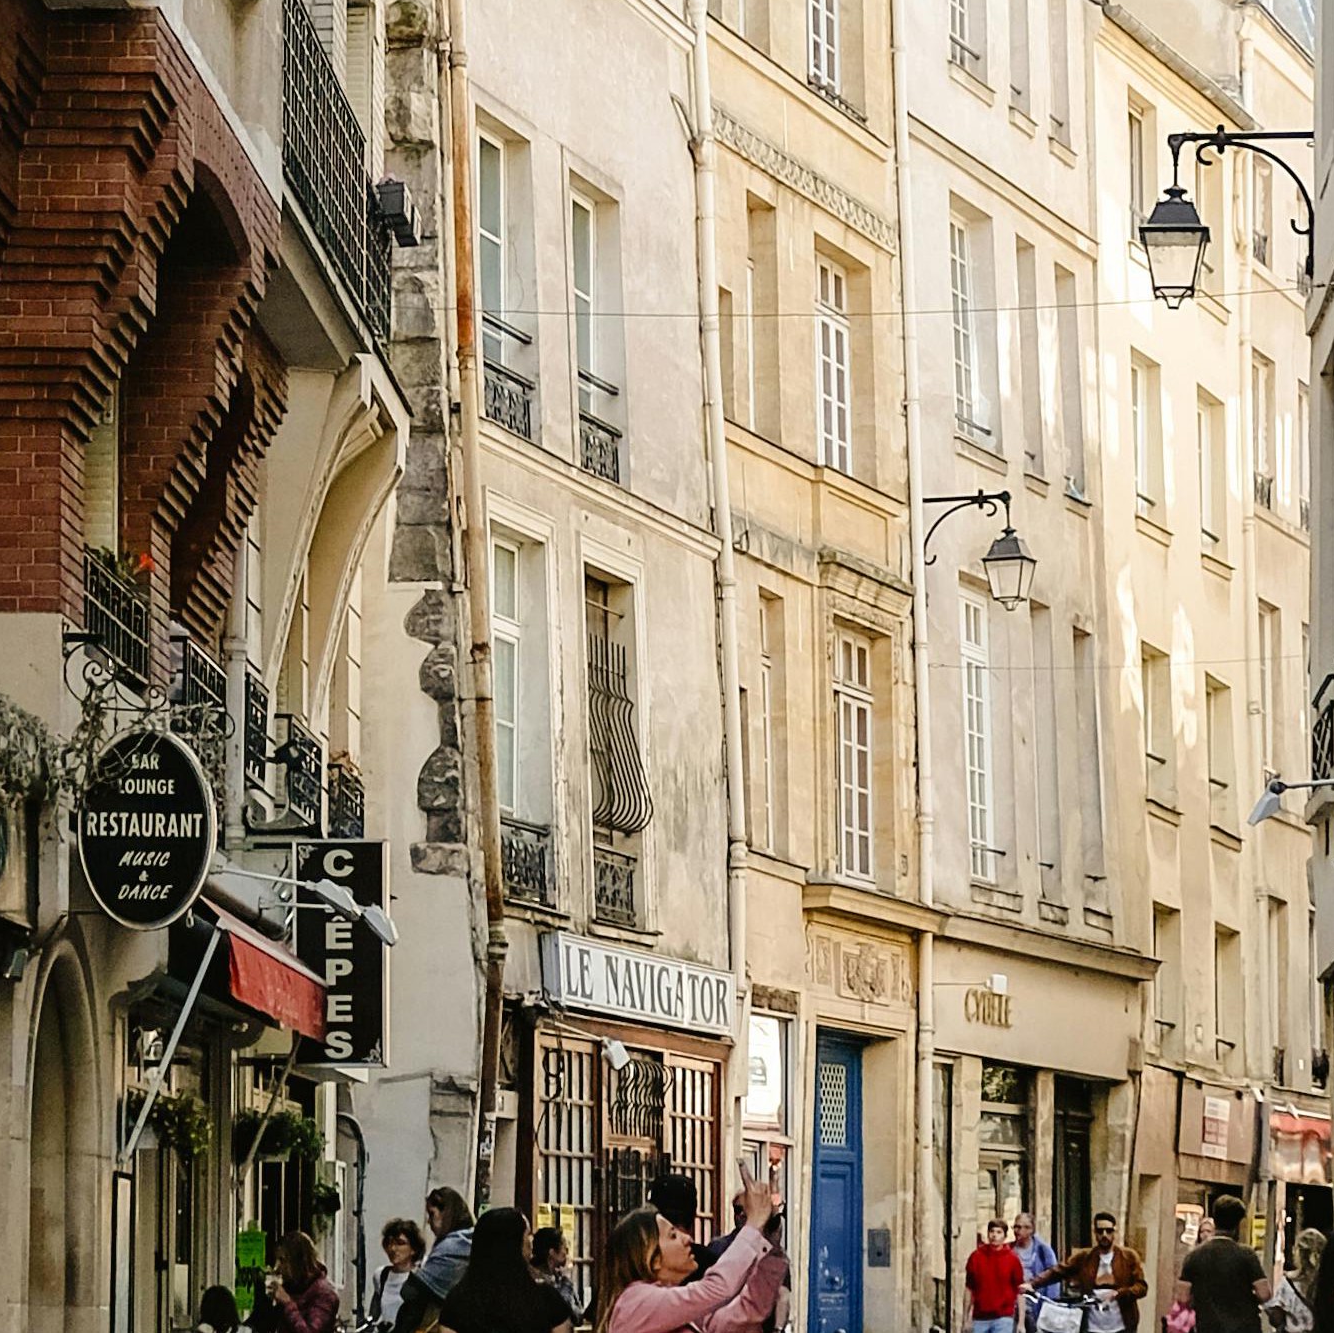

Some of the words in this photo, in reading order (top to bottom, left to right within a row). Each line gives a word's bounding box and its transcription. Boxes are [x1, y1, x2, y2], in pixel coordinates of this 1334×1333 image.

[131, 753, 160, 770] BAR
[119, 779, 175, 795] LOUNGE
[86, 812, 203, 838] RESTAURANT
[118, 851, 171, 867] MUSIC
[138, 870, 149, 882] &
[117, 884, 173, 900] DANCE
[323, 849, 354, 1059] CÊPES
[565, 945, 594, 1000] LE
[605, 955, 729, 1026] NAVIGATOR
